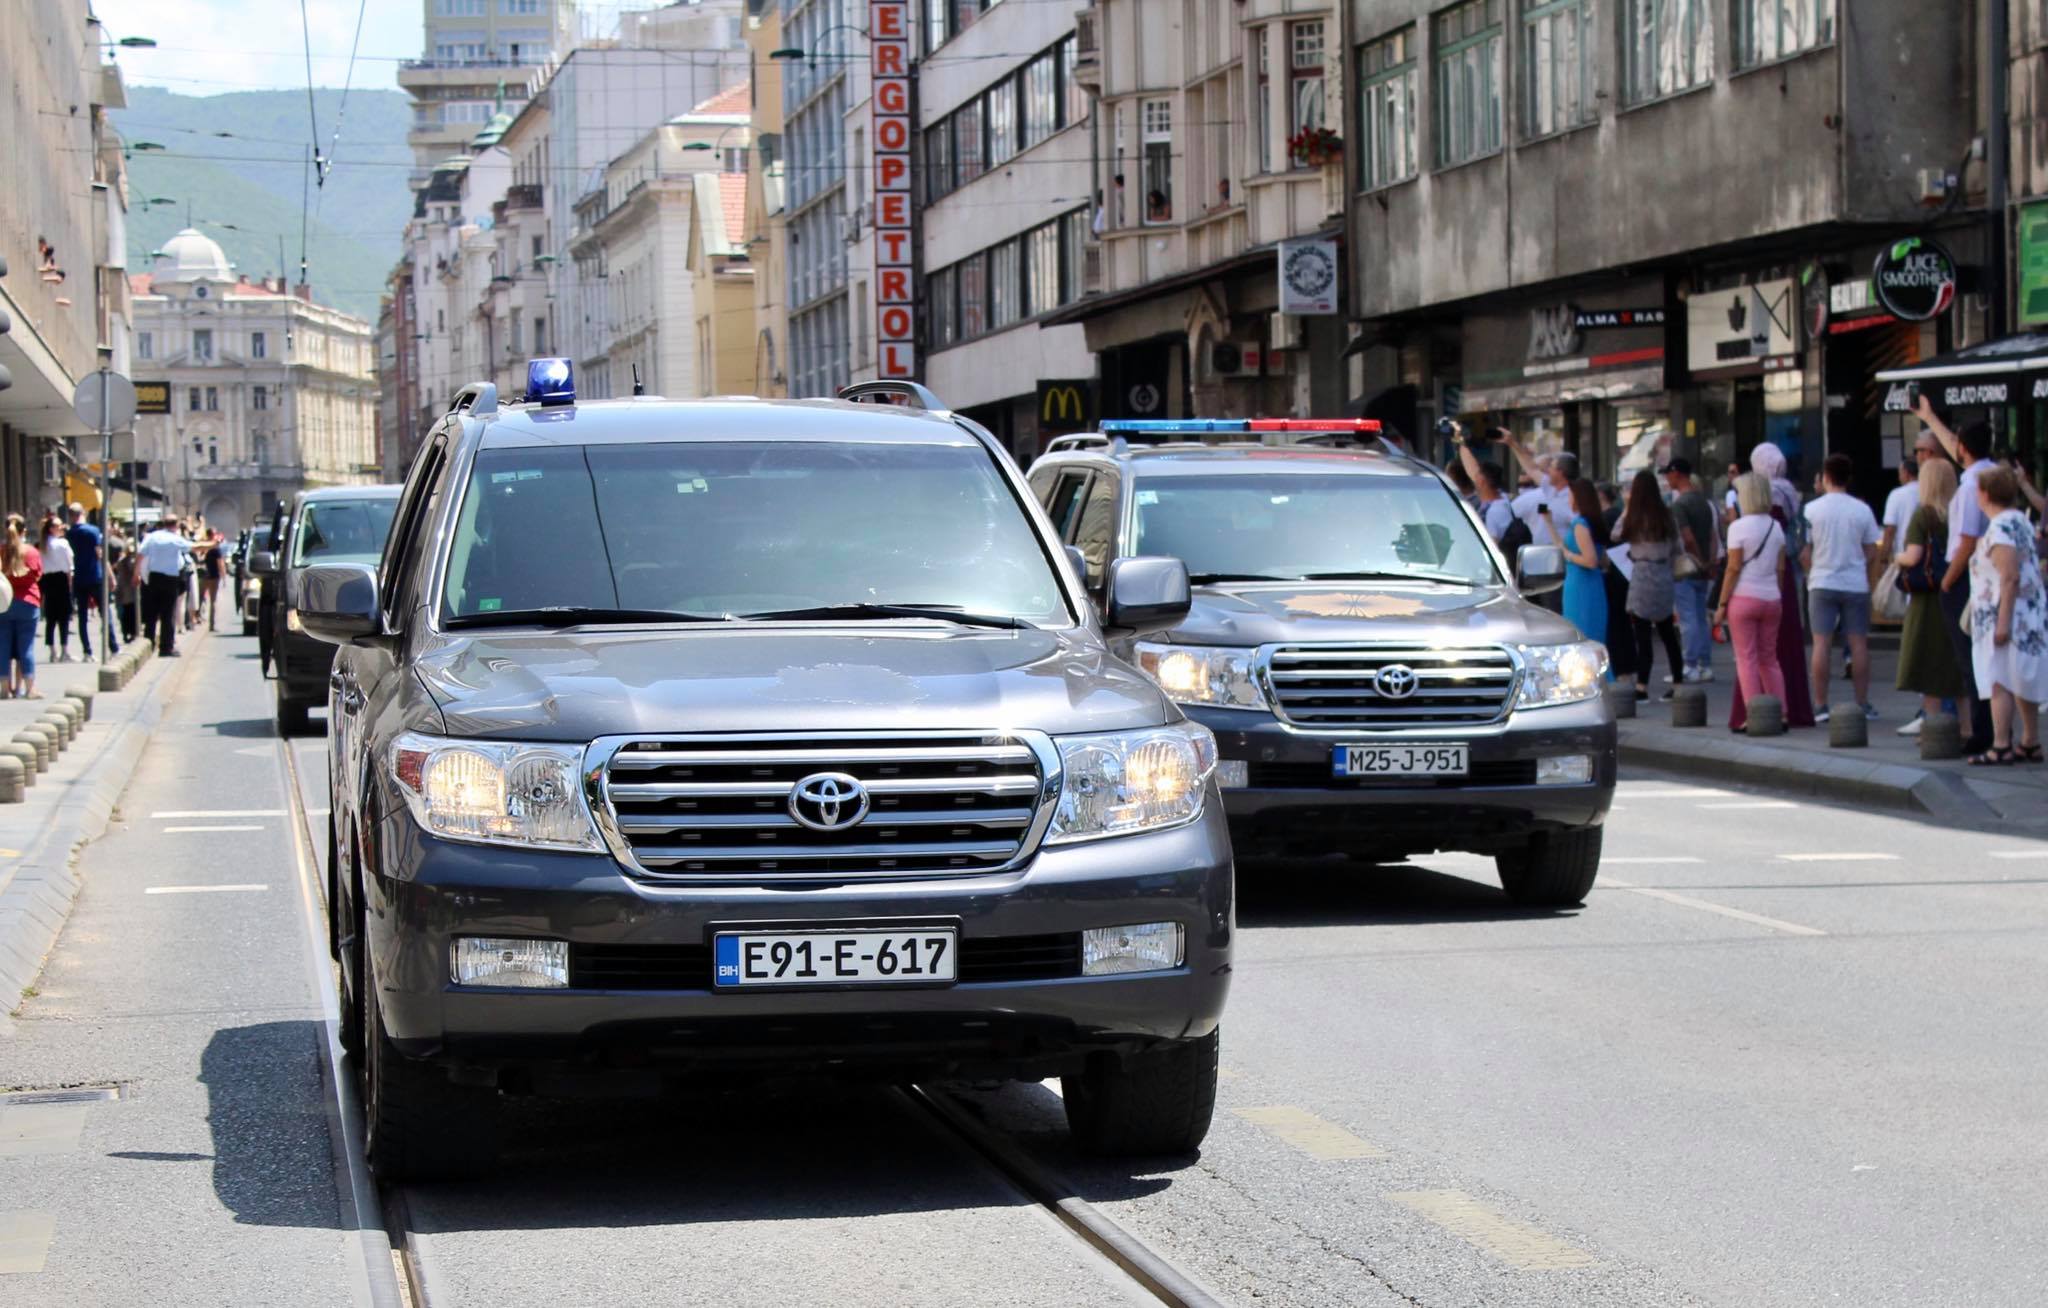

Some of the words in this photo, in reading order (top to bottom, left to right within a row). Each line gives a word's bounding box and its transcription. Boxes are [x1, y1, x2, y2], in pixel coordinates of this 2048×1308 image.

[878, 6, 910, 376] ERGOPETROL
[1904, 253, 1938, 272] JUICE
[1576, 314, 1618, 326] ALMA
[1944, 386, 1977, 405] GELATO
[1349, 749, 1464, 772] M25-J-951
[744, 938, 948, 978] E91-E-617
[718, 965, 739, 977] BIH
